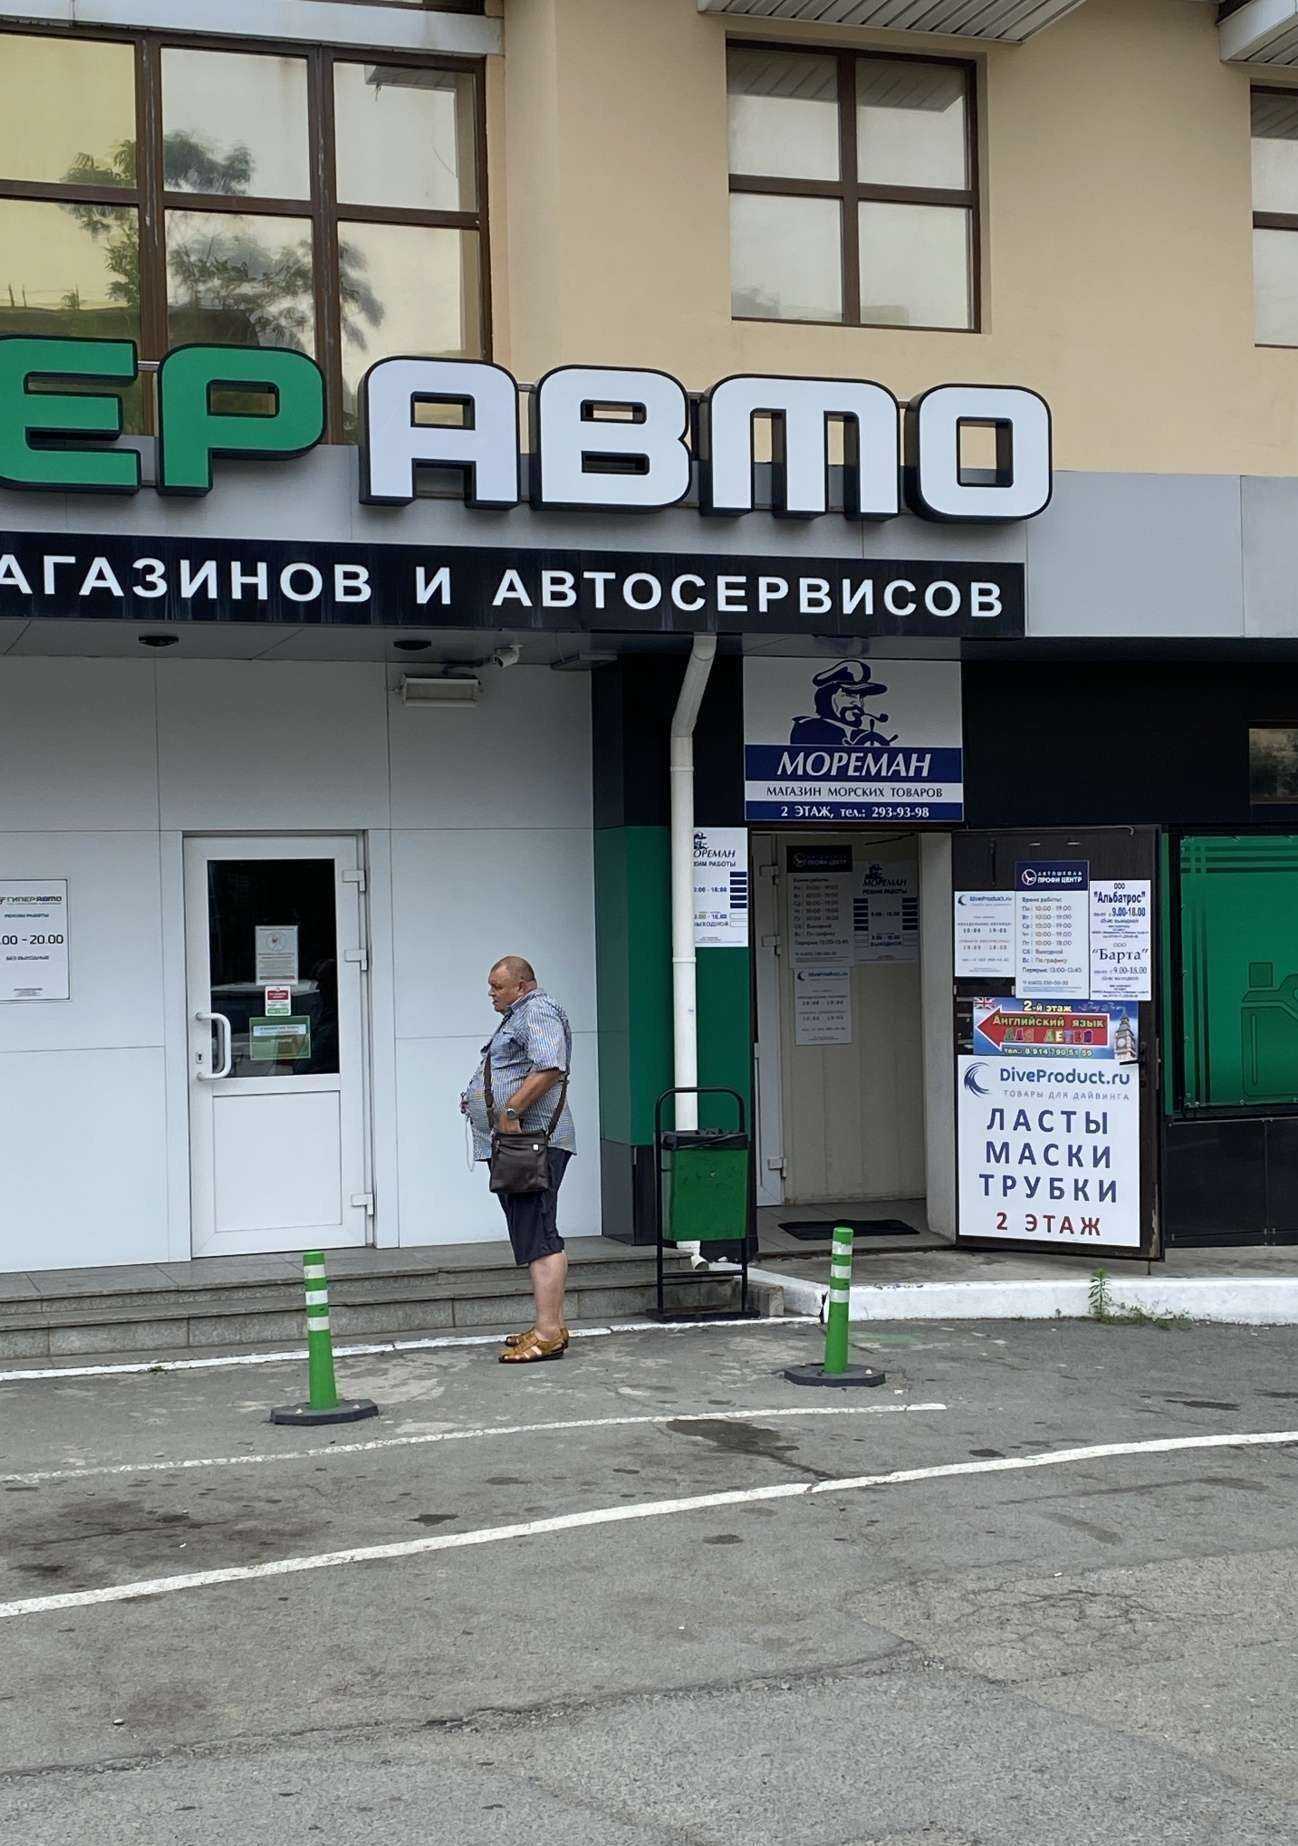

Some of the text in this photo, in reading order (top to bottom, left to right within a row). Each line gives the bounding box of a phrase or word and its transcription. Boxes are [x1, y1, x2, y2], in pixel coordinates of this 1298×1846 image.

[416, 567, 451, 605] И
[491, 568, 1003, 619] АВТОСЕРВИСОВ
[777, 752, 931, 777] МОРЕМАН
[767, 786, 943, 798] МАГАЗИН МОРСКИХ ТОВАРОВ
[781, 807, 788, 817] 2
[795, 806, 834, 819] ЭТАЖ,
[872, 807, 929, 818] 293-93-98
[1046, 1004, 1072, 1013] этаж
[993, 1016, 1105, 1028] Английский язык
[1000, 1066, 1130, 1085] DiveProduct.ru
[1003, 1090, 1129, 1101] ТОВАРЫ ДЛЯ ДАЙВИНГА
[987, 1108, 1108, 1134] ЛАСТЫ
[986, 1141, 1111, 1169] МАСКИ
[979, 1174, 1117, 1203] ТРУБКИ
[996, 1212, 1101, 1236] 2 ЭТАЖ
